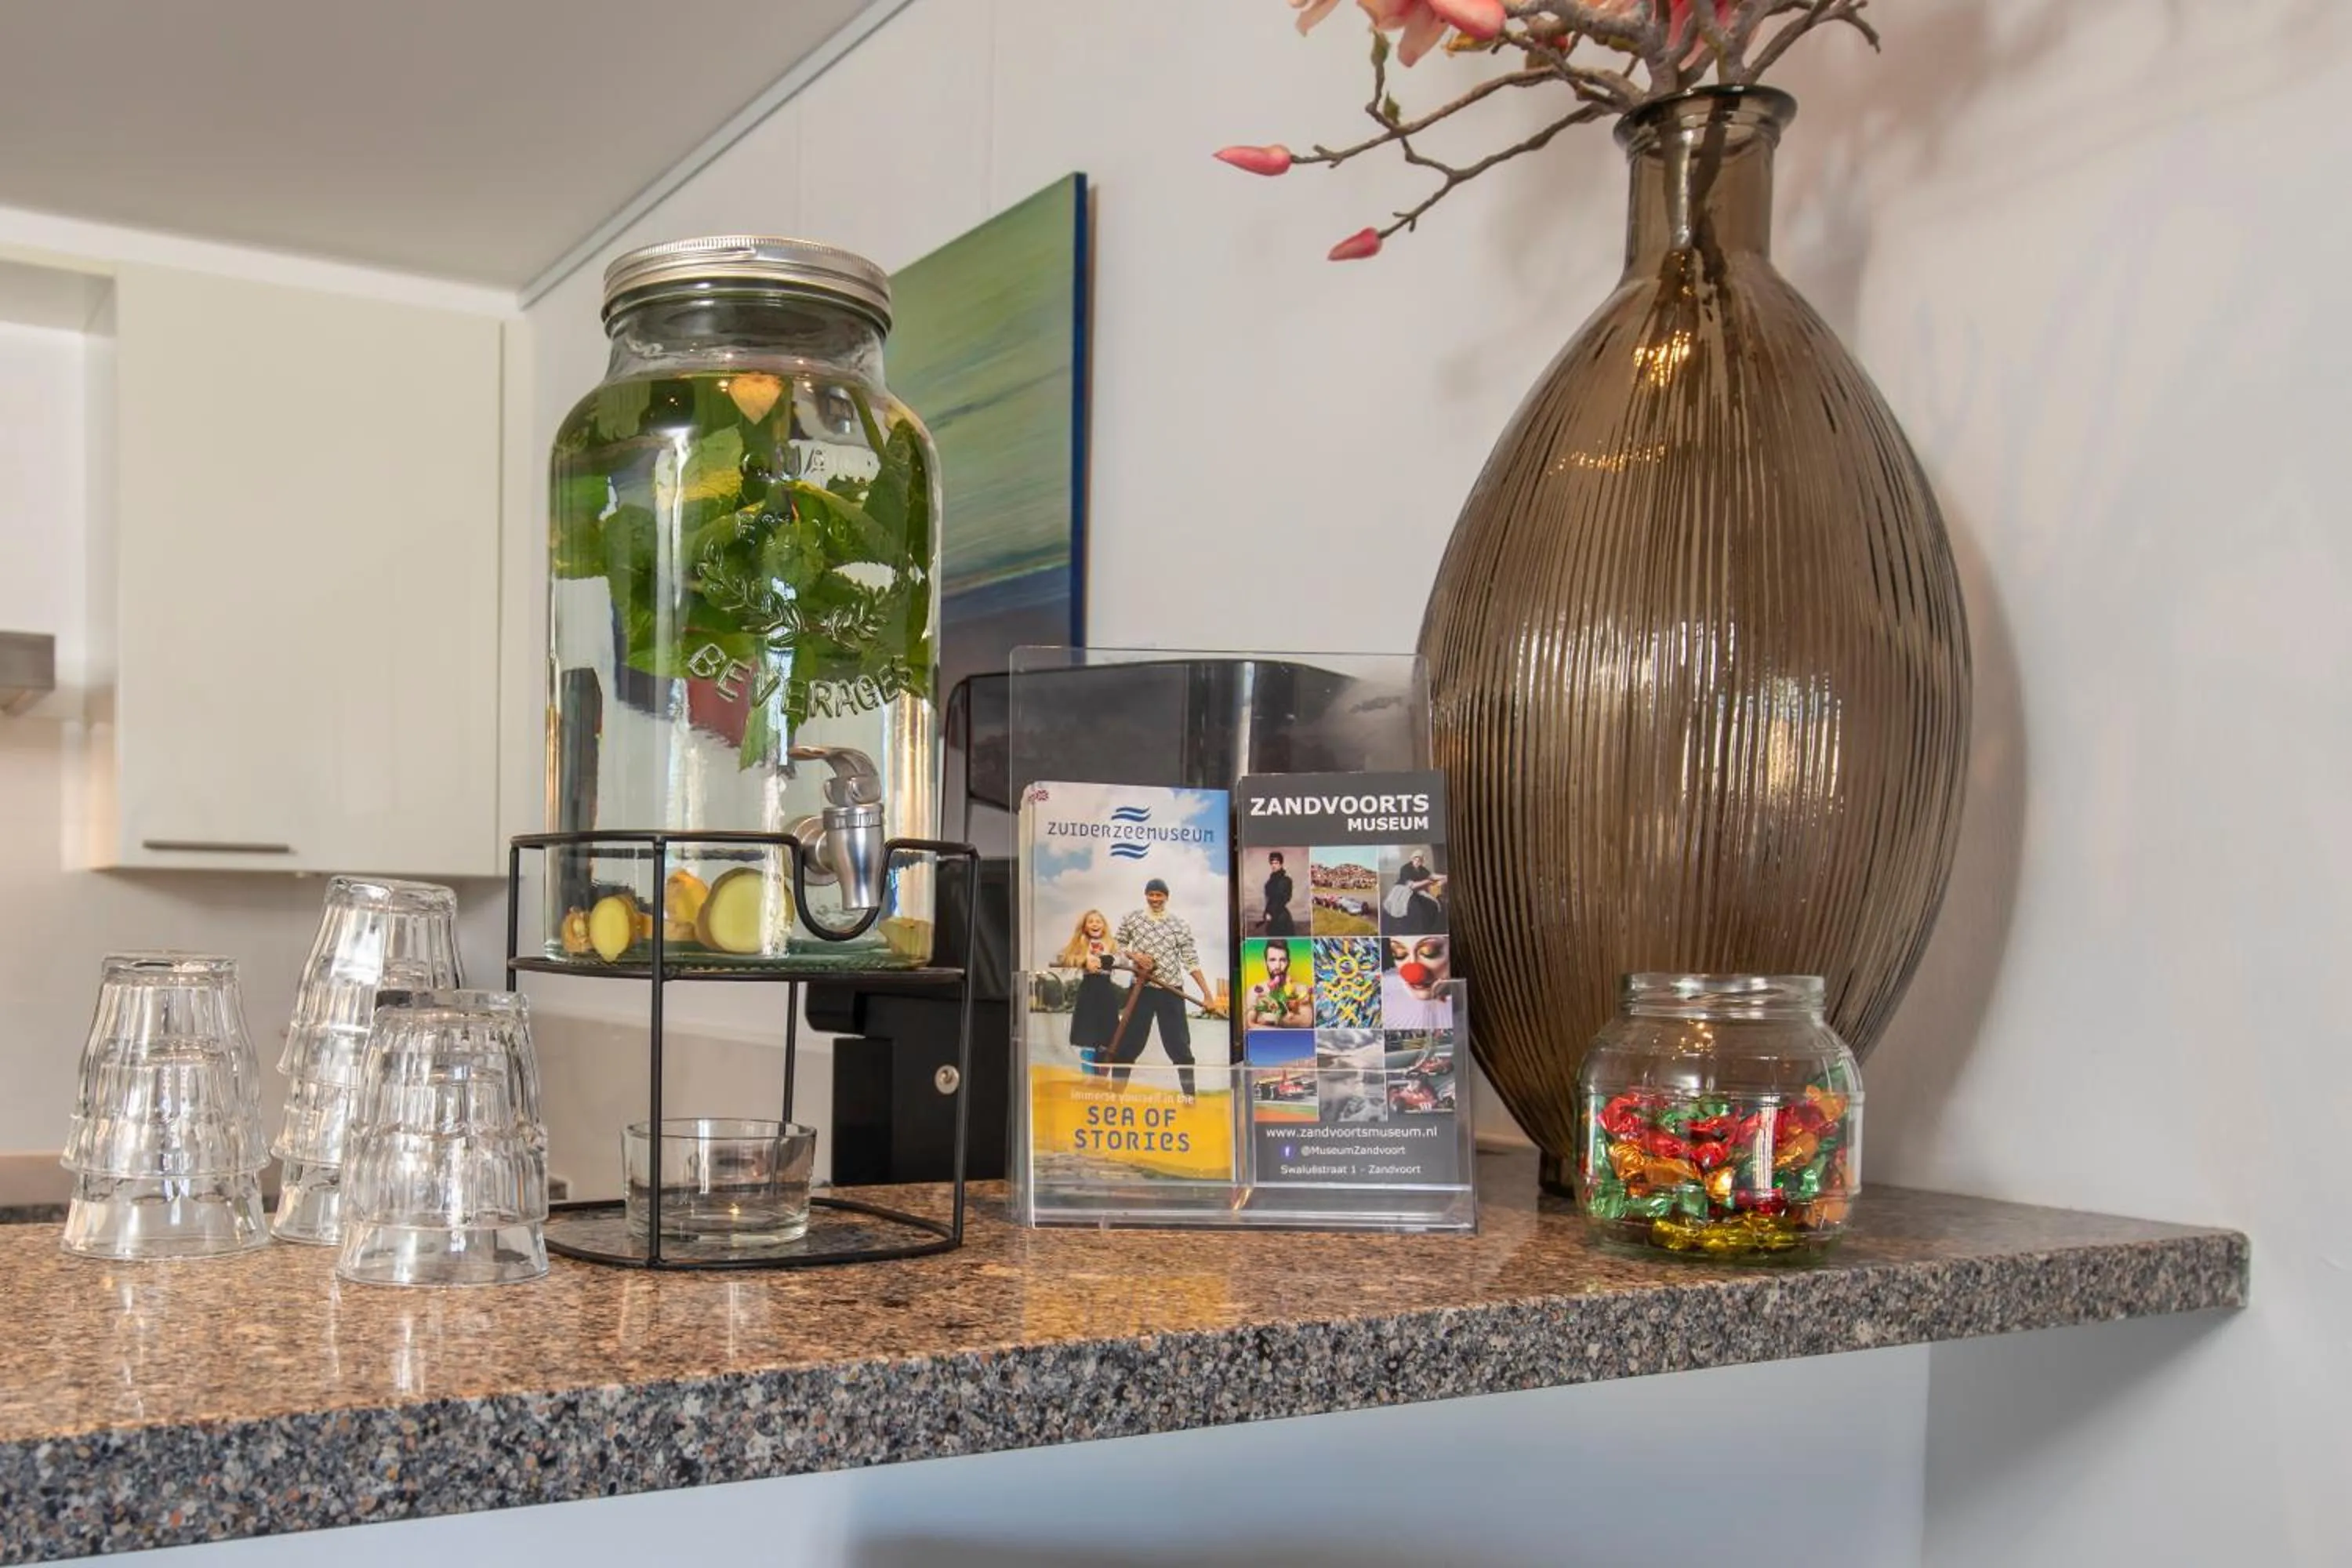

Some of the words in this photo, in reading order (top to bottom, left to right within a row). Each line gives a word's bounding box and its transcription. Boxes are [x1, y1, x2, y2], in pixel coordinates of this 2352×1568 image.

[688, 643, 913, 718] BEVERAGES
[1250, 793, 1430, 817] ZANDVOORTS
[1347, 815, 1429, 832] MUSEUM
[1177, 1091, 1195, 1105] the
[1145, 1107, 1176, 1128] OF
[1265, 1126, 1438, 1138] www.zandvoortsmuseum.nl
[1301, 1145, 1406, 1156] @MuseumZandvoort
[1368, 1164, 1421, 1174] Zandvoort
